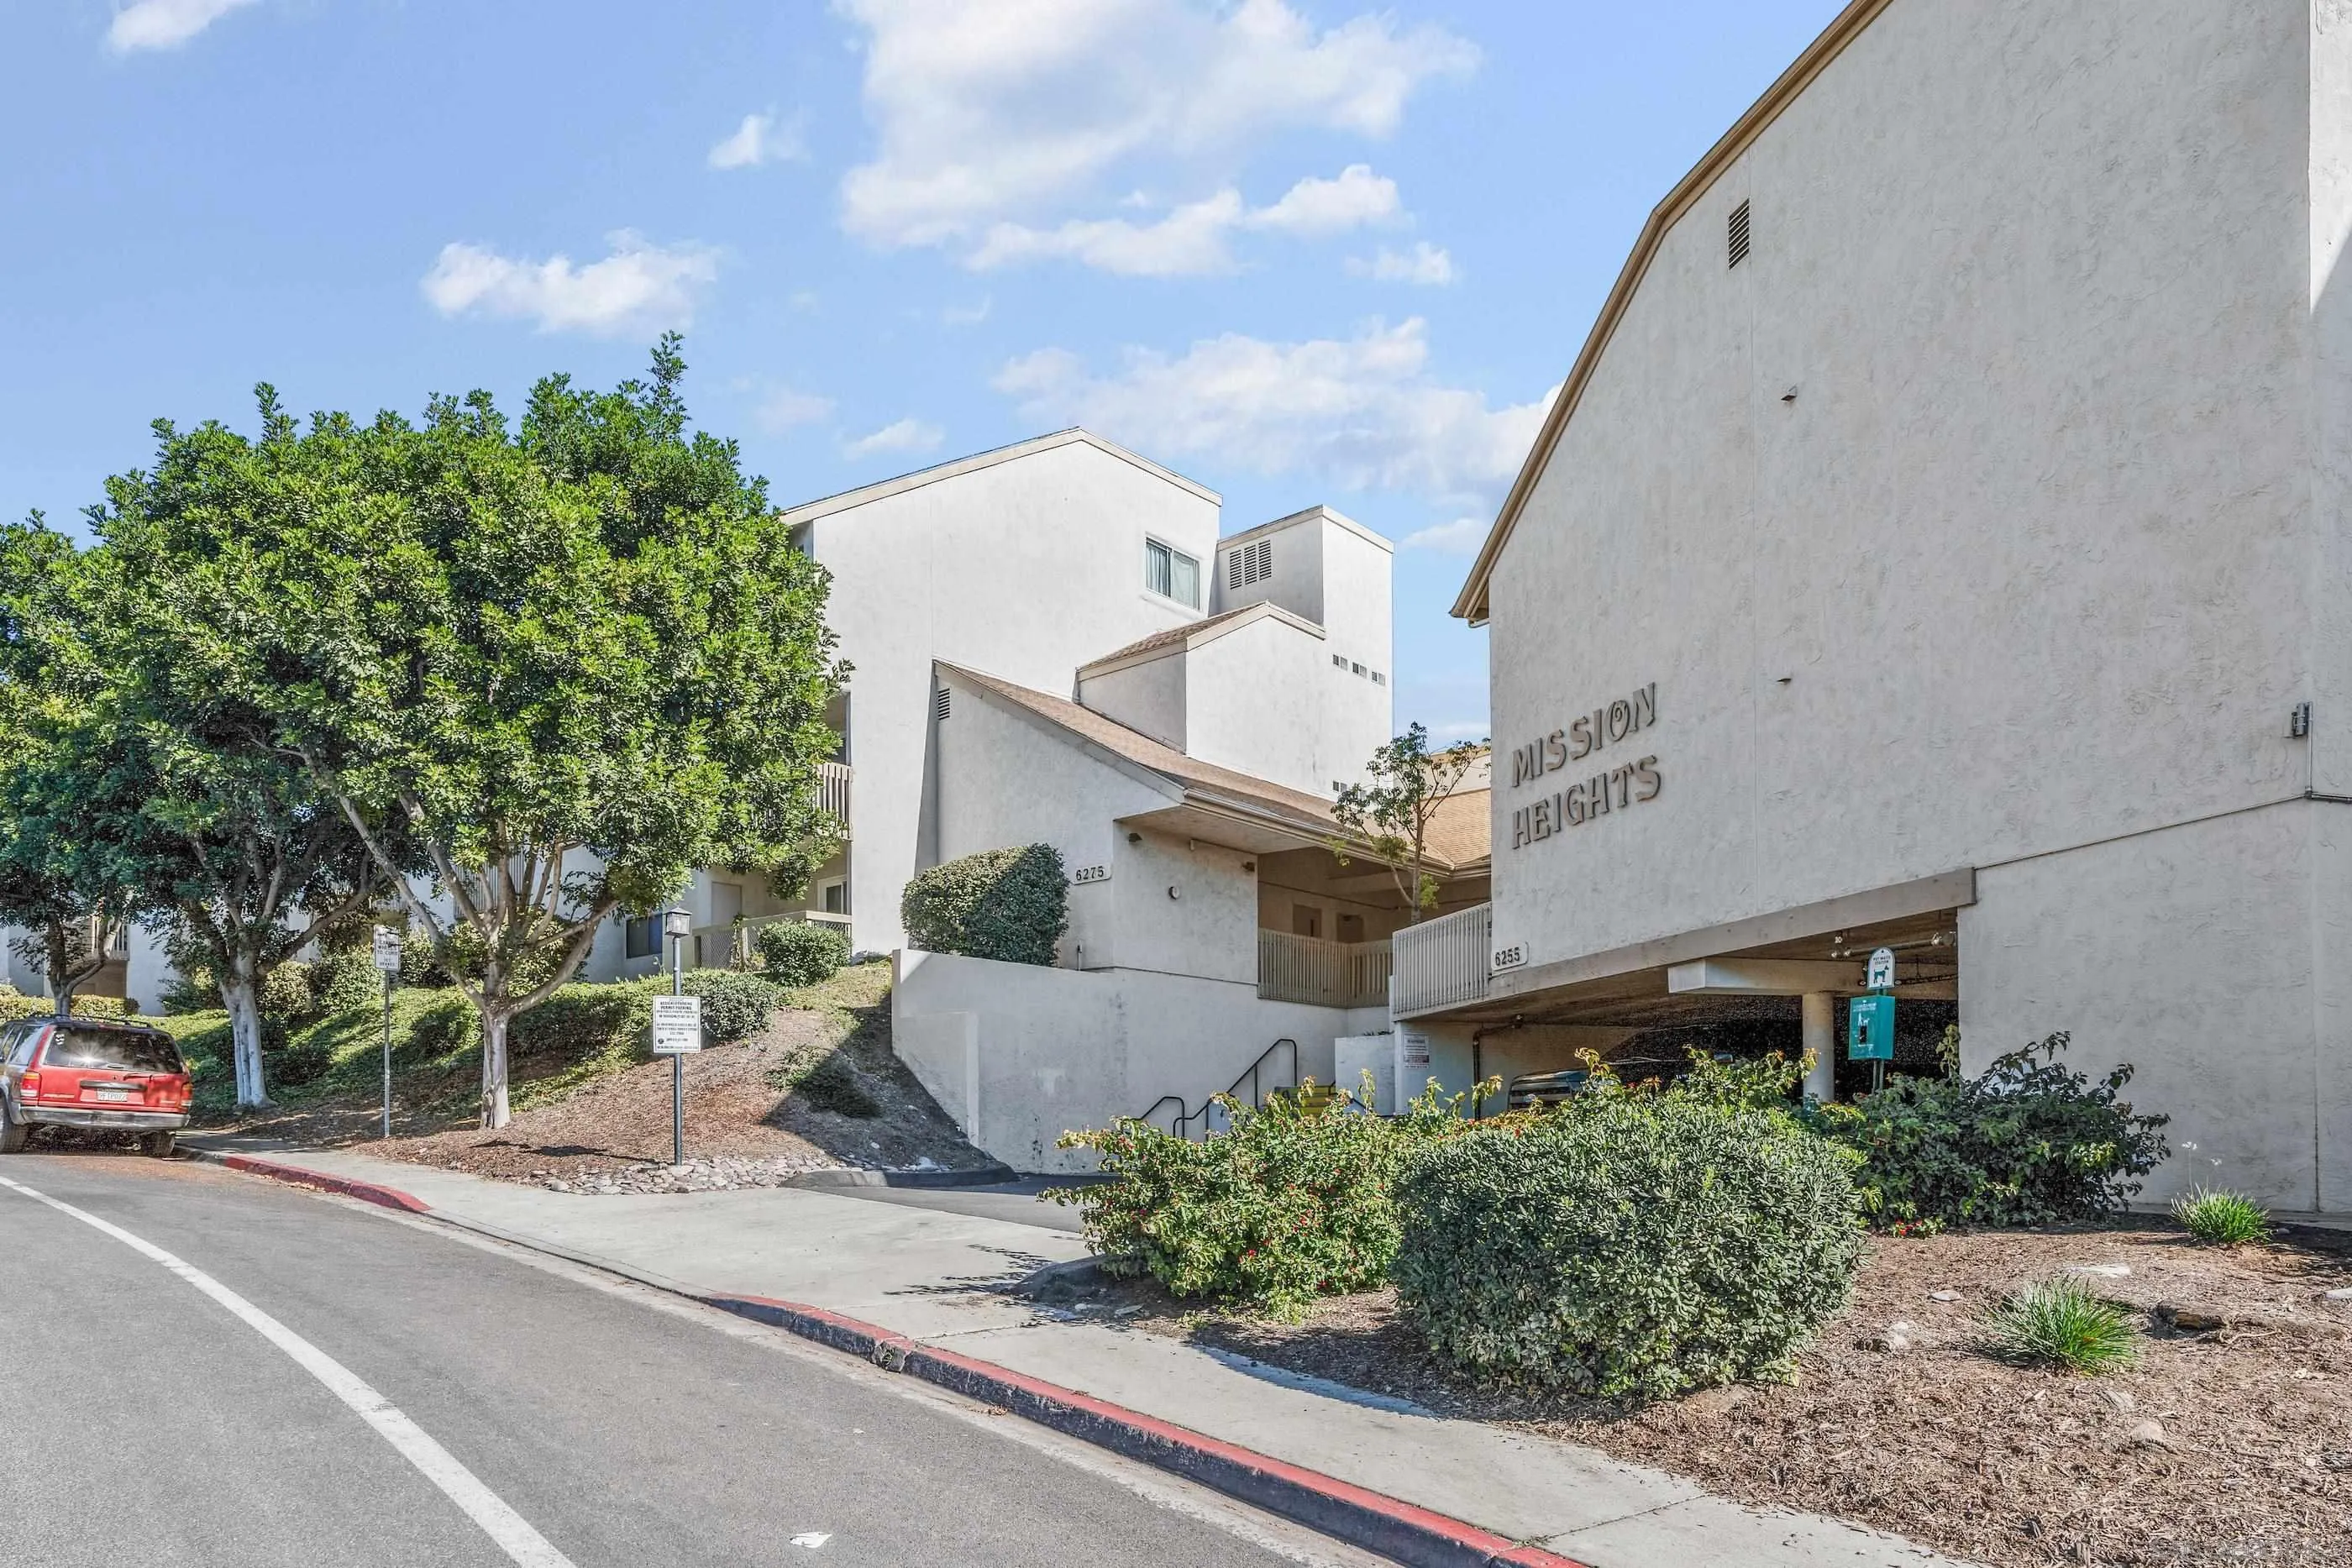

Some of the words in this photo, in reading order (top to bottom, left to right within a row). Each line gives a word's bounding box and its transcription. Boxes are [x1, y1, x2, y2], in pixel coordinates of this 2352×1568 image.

[1512, 682, 1655, 788] MISSION
[1512, 754, 1661, 850] HEIGHTS
[1076, 866, 1104, 881] 6275
[1495, 947, 1520, 966] 6255
